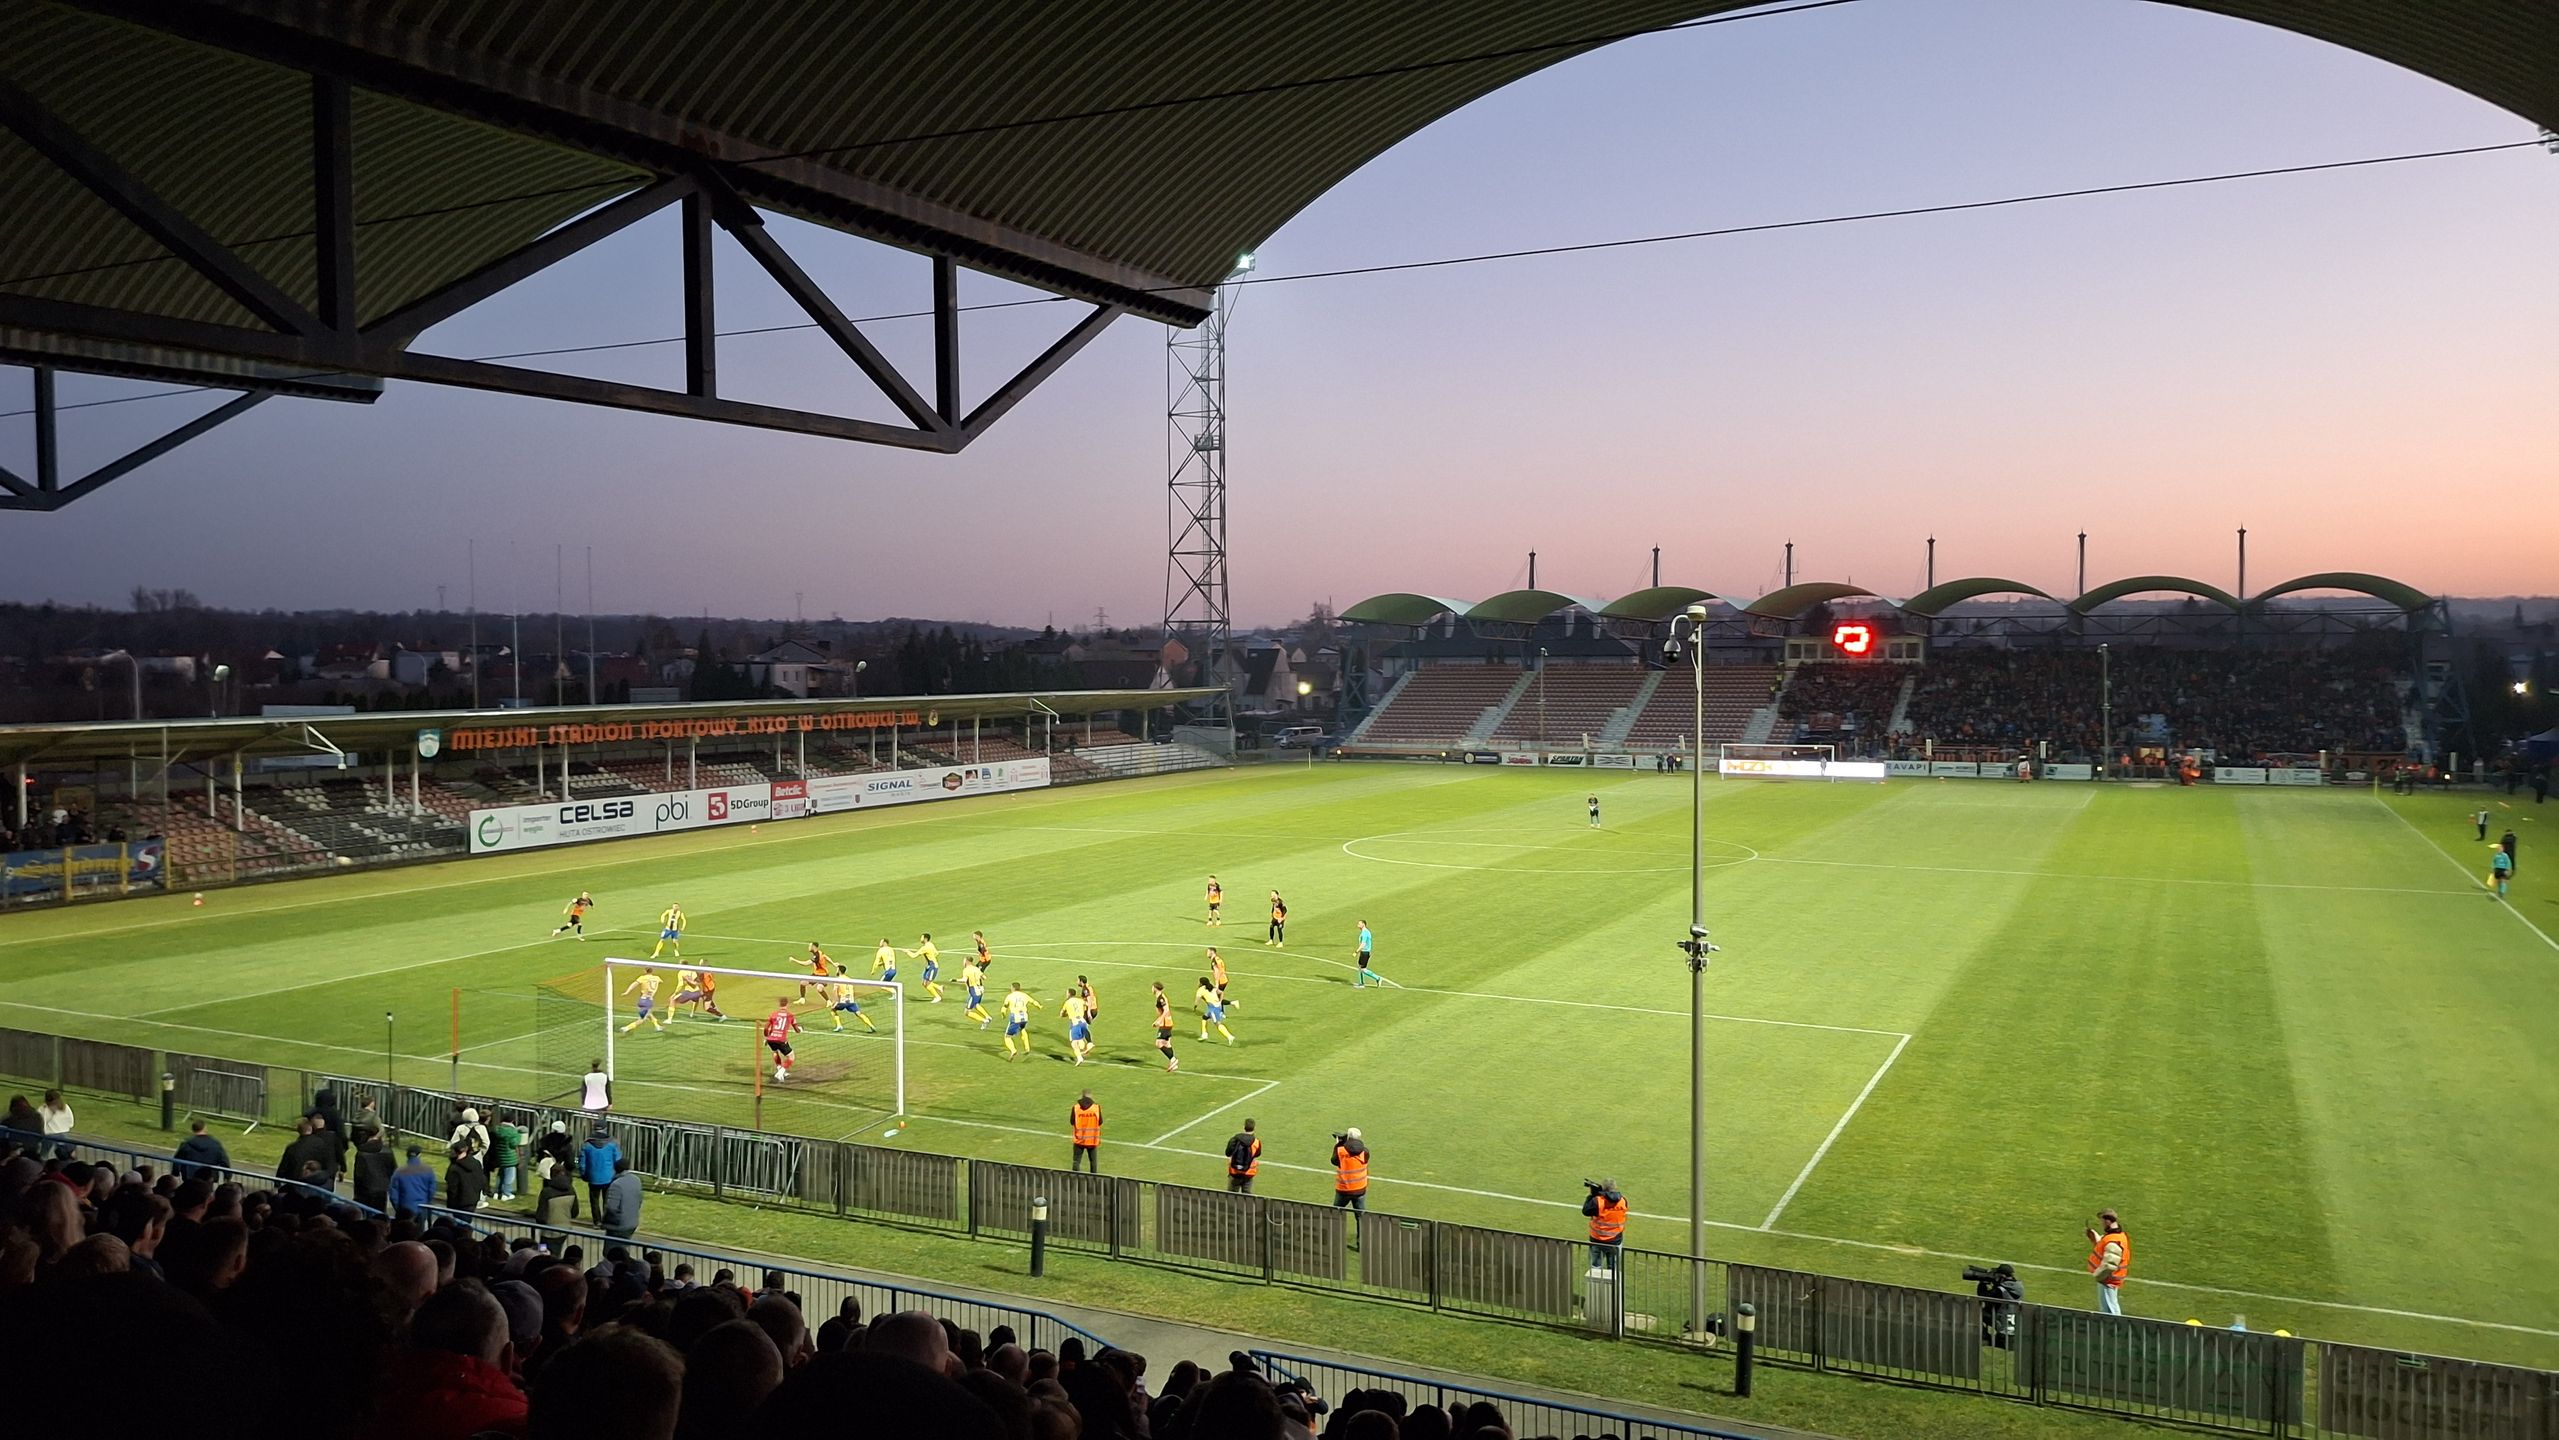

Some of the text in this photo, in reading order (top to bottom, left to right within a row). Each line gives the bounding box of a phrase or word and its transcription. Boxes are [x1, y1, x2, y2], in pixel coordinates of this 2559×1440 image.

[452, 727, 537, 750] MIEJSKI
[548, 722, 633, 745] STADION
[640, 716, 737, 739] SPORTOWY
[798, 713, 814, 732] W
[820, 710, 896, 732] OSTROWCU
[775, 784, 802, 797] Betclic
[867, 780, 913, 792] SIGNAL
[730, 798, 769, 810] 5DGroup
[656, 794, 688, 830] pbi
[559, 823, 626, 838] HUTA OSTROWIEC
[774, 1016, 788, 1031] 31
